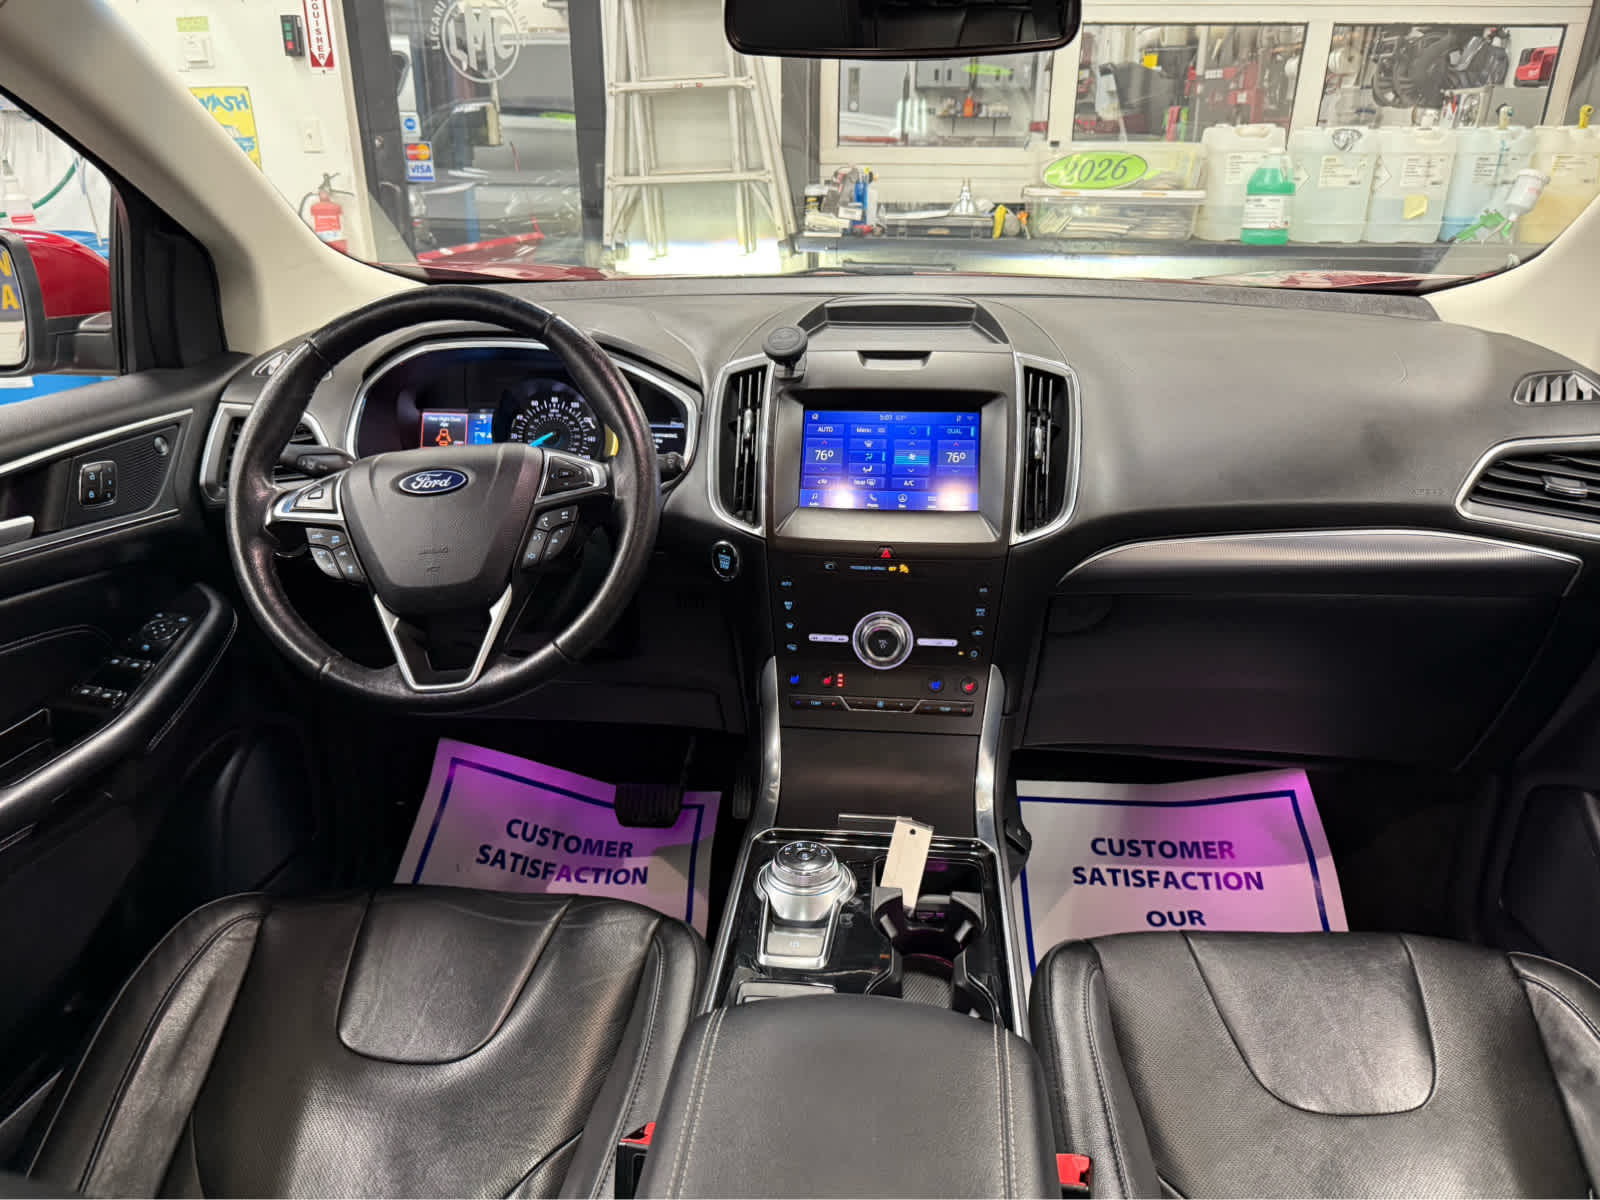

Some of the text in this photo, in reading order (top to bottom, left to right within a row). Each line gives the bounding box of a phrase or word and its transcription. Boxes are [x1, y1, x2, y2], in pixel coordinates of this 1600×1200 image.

[311, 0, 325, 60] GUISHER
[411, 164, 432, 174] VISA
[1064, 158, 1127, 183] 2026
[411, 473, 452, 490] Ford
[506, 818, 634, 859] CUSTOMER
[1090, 837, 1236, 860] CUSTOMER
[475, 844, 649, 885] SATISFACTION
[1072, 866, 1265, 891] SATISFACTION
[1146, 910, 1207, 928] OUR
